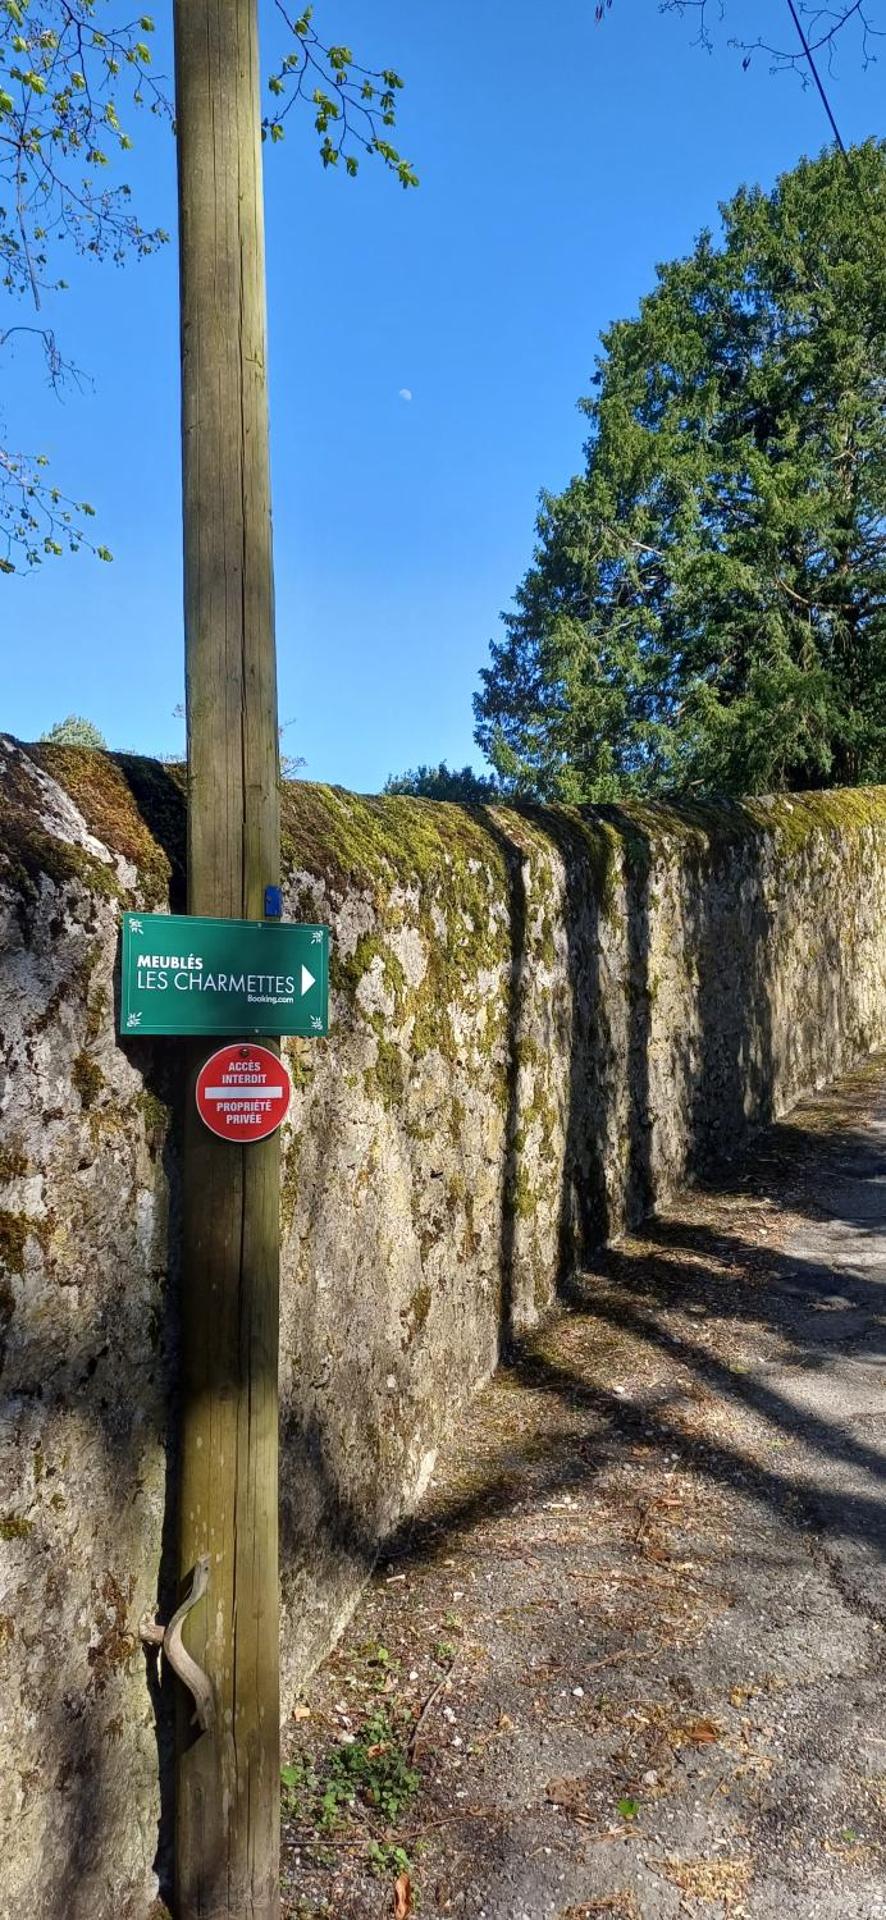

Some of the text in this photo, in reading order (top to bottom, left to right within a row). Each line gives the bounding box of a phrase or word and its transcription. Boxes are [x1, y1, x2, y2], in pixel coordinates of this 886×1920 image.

[137, 954, 203, 970] MEUBLÉS
[137, 971, 295, 994] LES CHARMETTES
[247, 994, 294, 1004] Booking.com
[222, 1074, 267, 1084] INTERDIT
[216, 1099, 272, 1112] PROPRIÉTÉ
[226, 1112, 262, 1124] PRIVÉE
